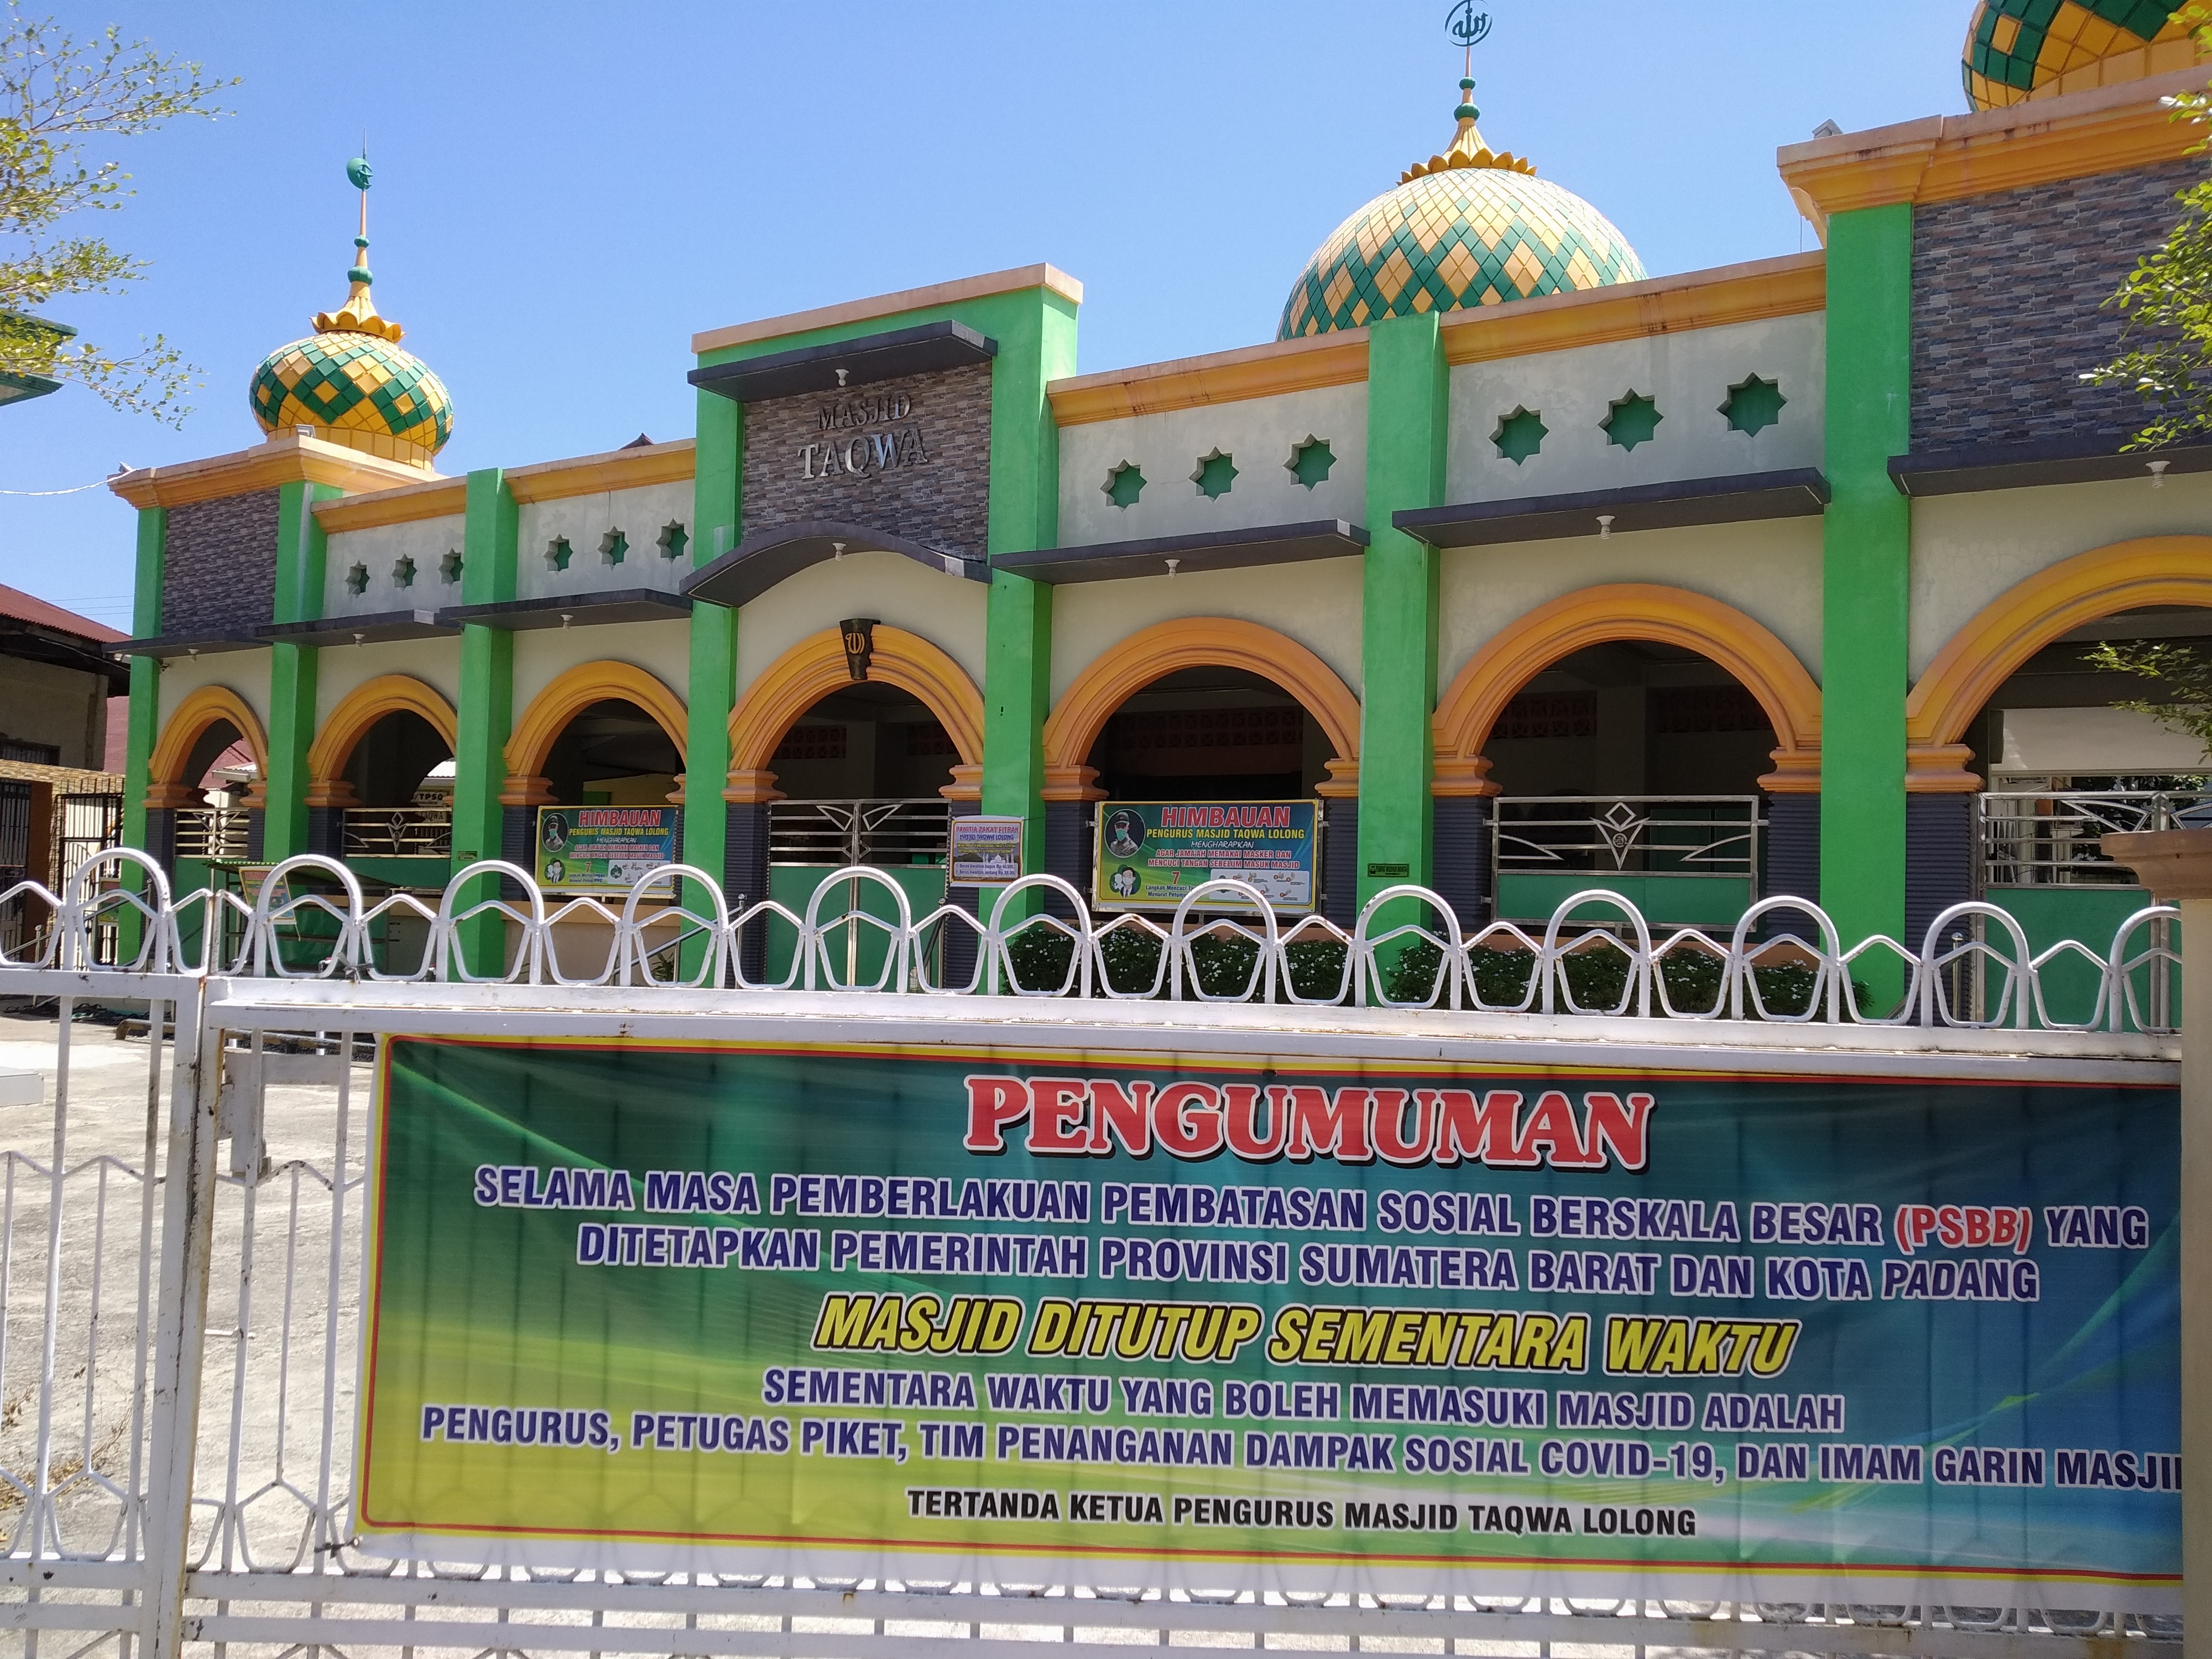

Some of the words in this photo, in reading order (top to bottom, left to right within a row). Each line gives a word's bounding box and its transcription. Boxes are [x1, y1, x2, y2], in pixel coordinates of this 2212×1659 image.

[816, 393, 911, 431] MASJID
[798, 427, 928, 479] TAQWA
[578, 810, 661, 827] HIMBAUAN
[624, 828, 644, 836] TAQWA
[1161, 806, 1291, 828] HIMBAUAN
[1146, 829, 1193, 839] PENGURUS
[1196, 829, 1230, 839] MASJID
[1233, 829, 1265, 840] TAQWA
[1268, 830, 1305, 839] LOLONG
[1191, 840, 1254, 848] MENGHARAPKAN
[586, 862, 591, 873] 7
[1147, 858, 1180, 867] MENCUCI
[1181, 859, 1209, 868] TANGAN
[1209, 859, 1242, 868] SEBELUM
[1243, 860, 1271, 869] MASUK
[1271, 860, 1300, 869] MASJID
[1155, 849, 1175, 857] AGAR
[1208, 849, 1242, 859] MEMAKAI
[1243, 850, 1274, 859] MASKER
[1276, 851, 1292, 859] DAN
[1172, 871, 1180, 885] 7
[964, 1074, 1656, 1171] PENGUMUMAN
[476, 1165, 633, 1210] SELAMA
[645, 1171, 760, 1214] MASA
[771, 1175, 1091, 1223] PEMBERLAKUAN
[1105, 1182, 1366, 1230] PEMBATASAN
[1378, 1190, 1521, 1235] SOSIAL
[1531, 1195, 1740, 1243] BERSKALA
[1751, 1202, 1884, 1247] BESAR
[1895, 1204, 2033, 1255] (PSBB)
[2044, 1206, 2149, 1249] YANG
[578, 1223, 820, 1270] DITETAPKAN
[832, 1229, 1089, 1279] PEMERINTAH
[1100, 1237, 1288, 1285] PROVINSI
[1300, 1243, 1518, 1292] SUMATERA
[1528, 1249, 1661, 1295] BARAT
[1671, 1253, 1754, 1298] DAN
[1766, 1257, 1872, 1302] KOTA
[1882, 1259, 2040, 1302] PADANG
[812, 1291, 1024, 1355] MASJID
[1026, 1297, 1264, 1361] DITUTUP
[1265, 1304, 1590, 1375] SEMENTARA
[1603, 1314, 1802, 1378] WAKTU
[763, 1366, 975, 1411] SEMENTARA
[986, 1374, 1111, 1414] WAKTU
[1121, 1378, 1213, 1418] YANG
[1223, 1381, 1339, 1422] BOLEH
[1351, 1384, 1546, 1428] MEMASUKI
[1557, 1390, 1694, 1432] MASJID
[1702, 1393, 1845, 1433] ADALAH
[421, 1404, 621, 1454] PENGURUS,
[631, 1411, 792, 1454] PETUGAS
[800, 1418, 908, 1465] PIKET,
[919, 1421, 987, 1461] TIM
[997, 1424, 1234, 1469] PENANGANAN
[1244, 1431, 1394, 1473] DAMPAK
[1405, 1436, 1531, 1477] SOSIAL
[1540, 1439, 1725, 1486] COVID-19,
[1736, 1443, 1809, 1483] DAN
[1818, 1444, 1923, 1484] IMAM
[1933, 1447, 2046, 1488] GARIN
[907, 1488, 1060, 1521] TERTANDA
[1069, 1491, 1165, 1526] KETUA
[1173, 1496, 1334, 1530] PENGURUS
[1343, 1501, 1459, 1533] MASJID
[1468, 1504, 1574, 1537] TAQWA
[1583, 1507, 1696, 1537] LOLONG
